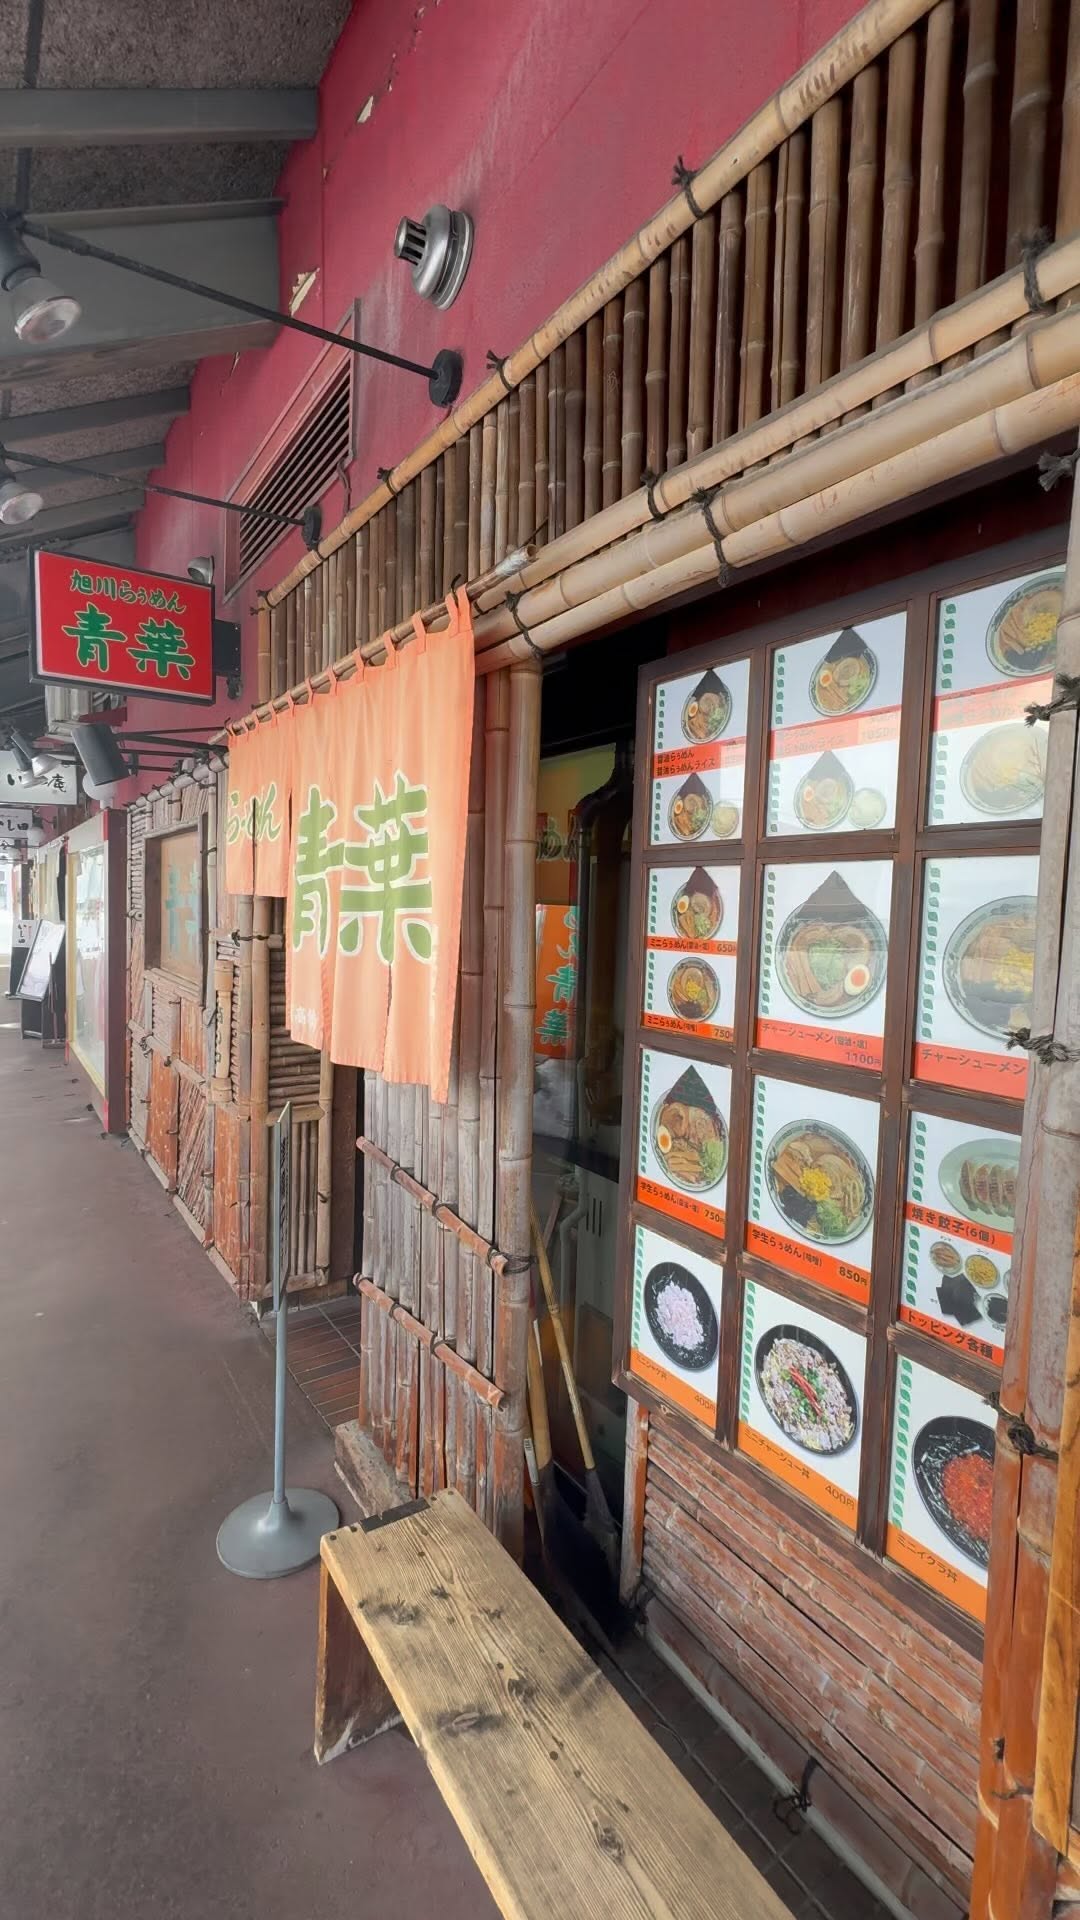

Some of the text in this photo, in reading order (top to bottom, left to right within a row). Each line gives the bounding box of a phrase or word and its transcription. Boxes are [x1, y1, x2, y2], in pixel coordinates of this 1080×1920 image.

[293, 768, 433, 966] 青葉
[921, 1048, 1026, 1075] チャーシューメン
[838, 1266, 868, 1286] 850円
[825, 1484, 855, 1510] 400円
[896, 1534, 959, 1583] ミニイクラ丼
